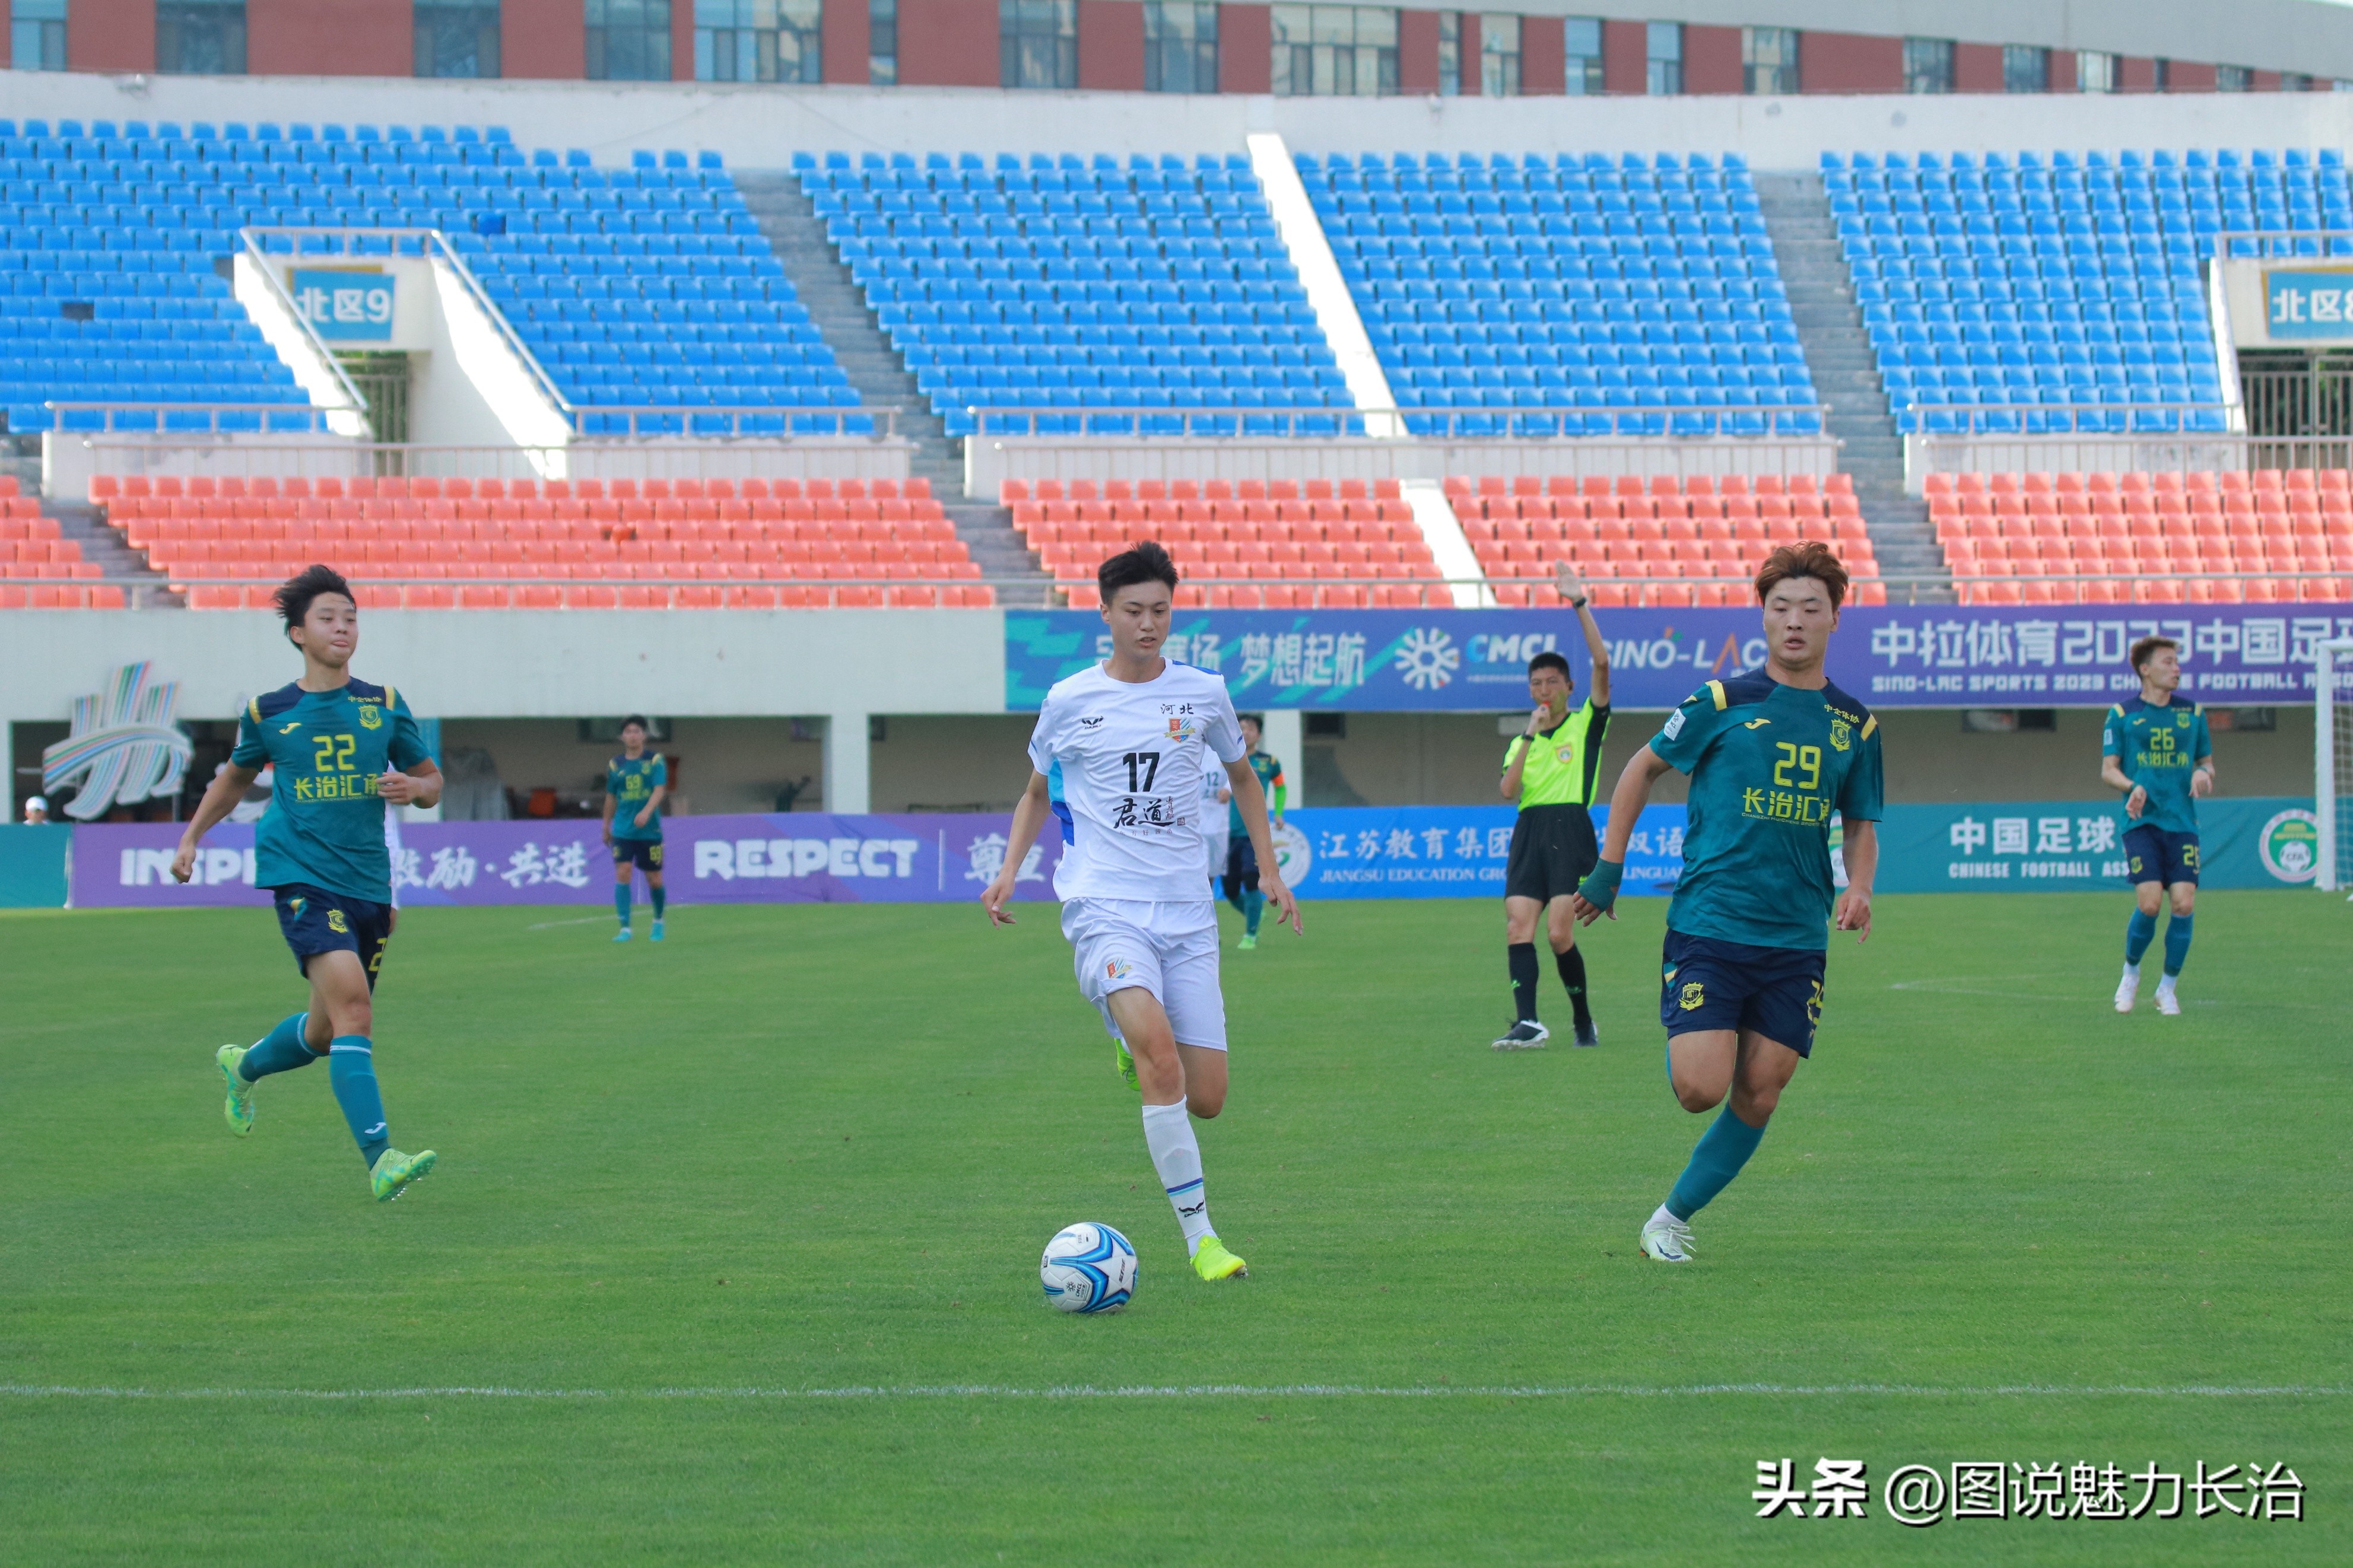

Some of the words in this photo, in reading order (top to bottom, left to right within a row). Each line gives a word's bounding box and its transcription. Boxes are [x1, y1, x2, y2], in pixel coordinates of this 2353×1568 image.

[297, 287, 391, 322] 北区9
[1240, 631, 1367, 687] 梦想起航
[1968, 674, 2047, 692] SPORTS
[2053, 674, 2105, 691] 2023
[2198, 672, 2298, 689] FOOTBALL
[1160, 702, 1194, 715] 河北
[312, 733, 356, 772] 22
[2149, 727, 2175, 751] 26
[1123, 752, 1160, 793] 17
[1206, 771, 1220, 787] 12
[1773, 741, 1821, 790] 29
[1113, 797, 1176, 828] 君道
[1319, 826, 1514, 860] 江苏教育集团
[1950, 816, 2116, 855] 中国足球
[694, 838, 918, 880] RESPECT
[1319, 869, 1384, 883] JIANGSU
[1388, 867, 1475, 882] EDUCATION
[1949, 862, 2009, 878] CHINESE
[2021, 862, 2090, 877] FOOTBALL
